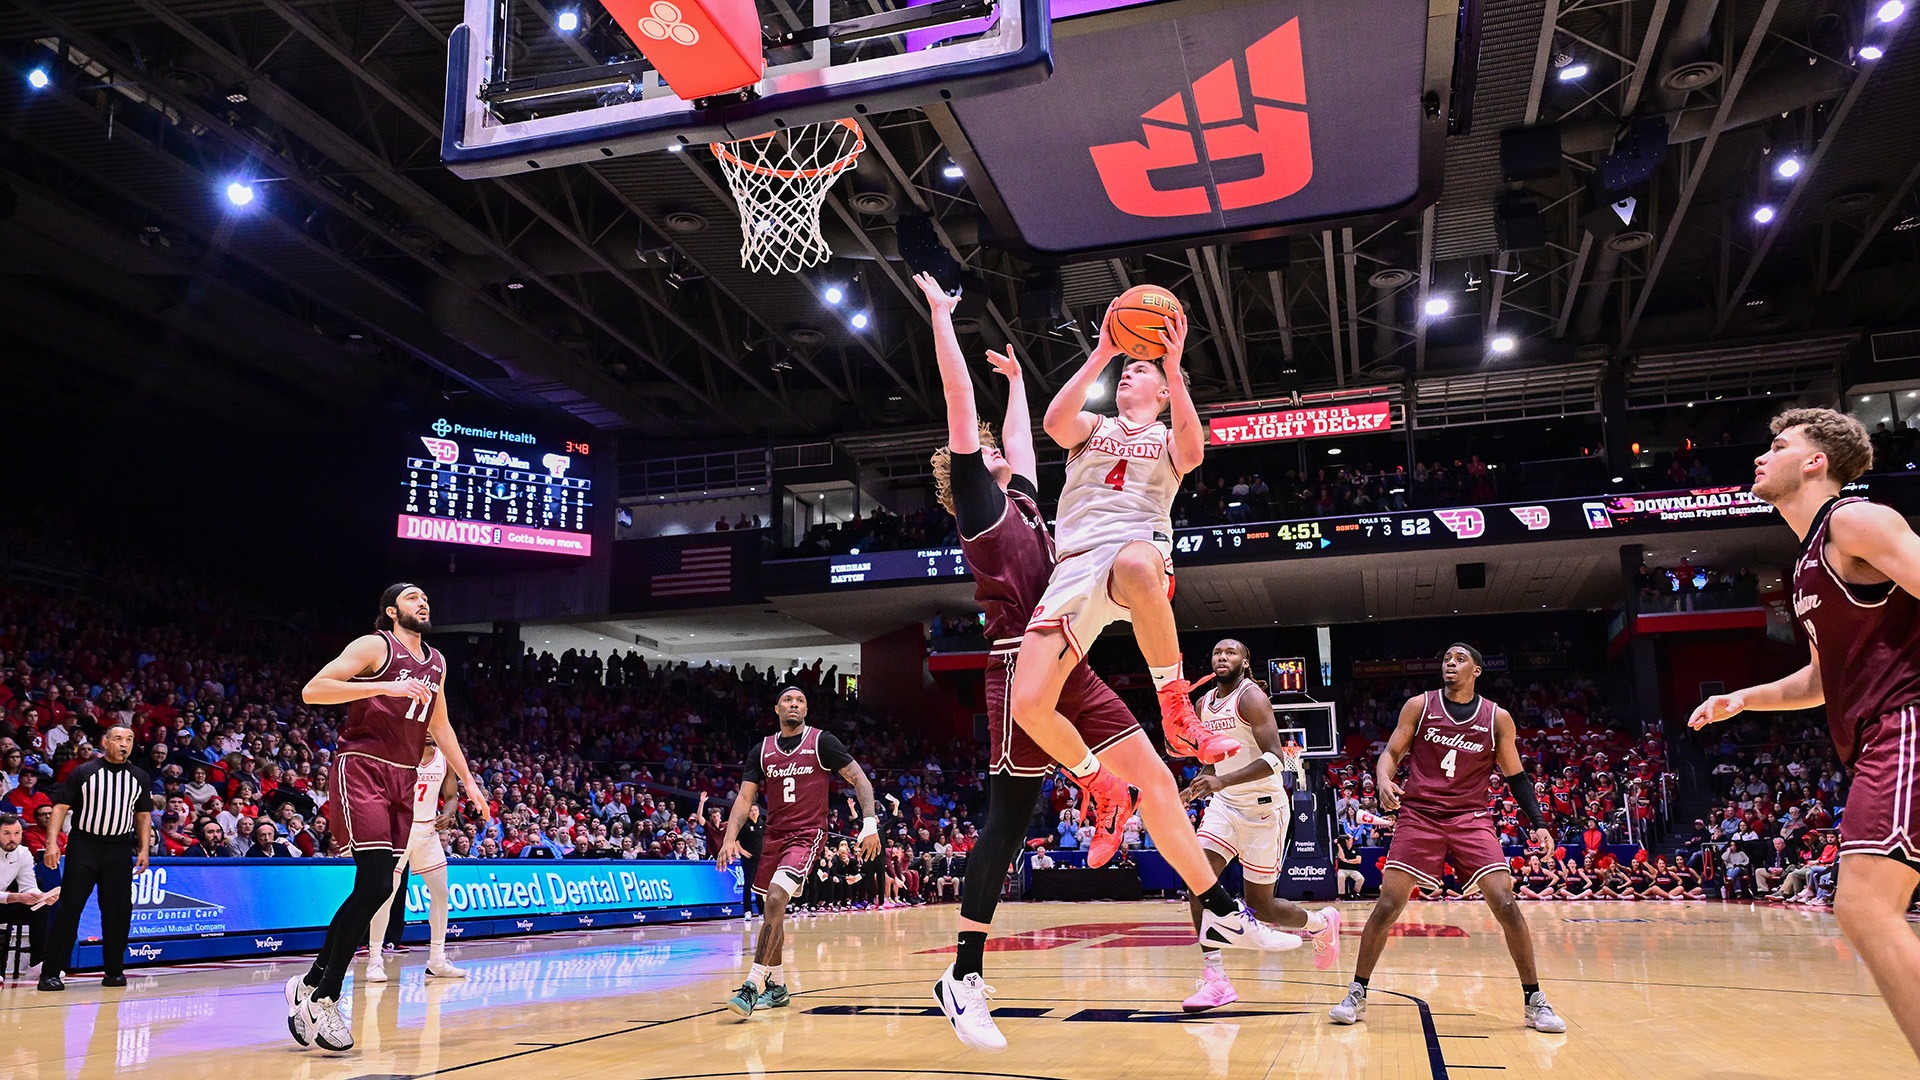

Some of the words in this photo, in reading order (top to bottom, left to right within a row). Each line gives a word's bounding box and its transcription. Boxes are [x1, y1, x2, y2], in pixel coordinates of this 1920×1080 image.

[1142, 293, 1179, 313] ELITE
[1247, 413, 1278, 426] THE
[1285, 407, 1351, 422] CONNOR
[454, 423, 498, 439] Premier
[500, 430, 537, 445] Health
[1226, 419, 1308, 442] FLIGHT
[1313, 413, 1375, 434] DECK
[566, 441, 589, 455] 3:48
[1089, 436, 1163, 461] DAYTON
[468, 466, 476, 475] A
[1104, 459, 1128, 492] 4
[528, 474, 536, 482] P
[561, 478, 569, 487] A
[578, 480, 585, 488] F
[1633, 493, 1732, 513] DOWNLOAD
[506, 515, 517, 523] 77
[1660, 509, 1696, 521] Dayton
[1697, 507, 1727, 518] Flyers
[1728, 503, 1774, 515] Gameday
[407, 517, 492, 544] DONATOS
[1227, 527, 1246, 535] FOULS
[1277, 522, 1322, 541] 4:51
[1335, 524, 1360, 532] BONUS
[1365, 525, 1373, 537] 7
[1383, 524, 1392, 536] 3
[1401, 518, 1431, 536] 52
[507, 532, 535, 545] Gotta
[536, 535, 555, 547] love
[557, 540, 584, 550] more.
[1176, 535, 1204, 553] 47
[1217, 537, 1223, 548] 1
[1233, 536, 1242, 547] 9
[1246, 532, 1270, 540] BONUS
[1295, 541, 1313, 550] 2ND
[831, 563, 871, 573] FORDHAM
[928, 557, 935, 566] 5
[955, 555, 962, 564] 8
[831, 574, 865, 584] DAYTON
[927, 567, 938, 577] 10
[954, 566, 965, 575] 12
[1278, 661, 1303, 672] 4:51
[1283, 672, 1300, 690] 11
[1424, 727, 1484, 753] Fordham
[767, 762, 814, 778] Fordham
[1440, 749, 1458, 778] 4
[418, 784, 428, 802] 7
[783, 777, 796, 803] 2
[1287, 865, 1327, 877] altafiber
[405, 873, 546, 912] usomized
[546, 871, 620, 905] Dental
[620, 871, 673, 902] Plans
[132, 911, 153, 921] rior
[157, 910, 191, 920] Dental
[140, 926, 168, 934] Medical
[194, 923, 226, 932] Company
[263, 936, 283, 951] Kroger
[139, 944, 163, 961] Kroger
